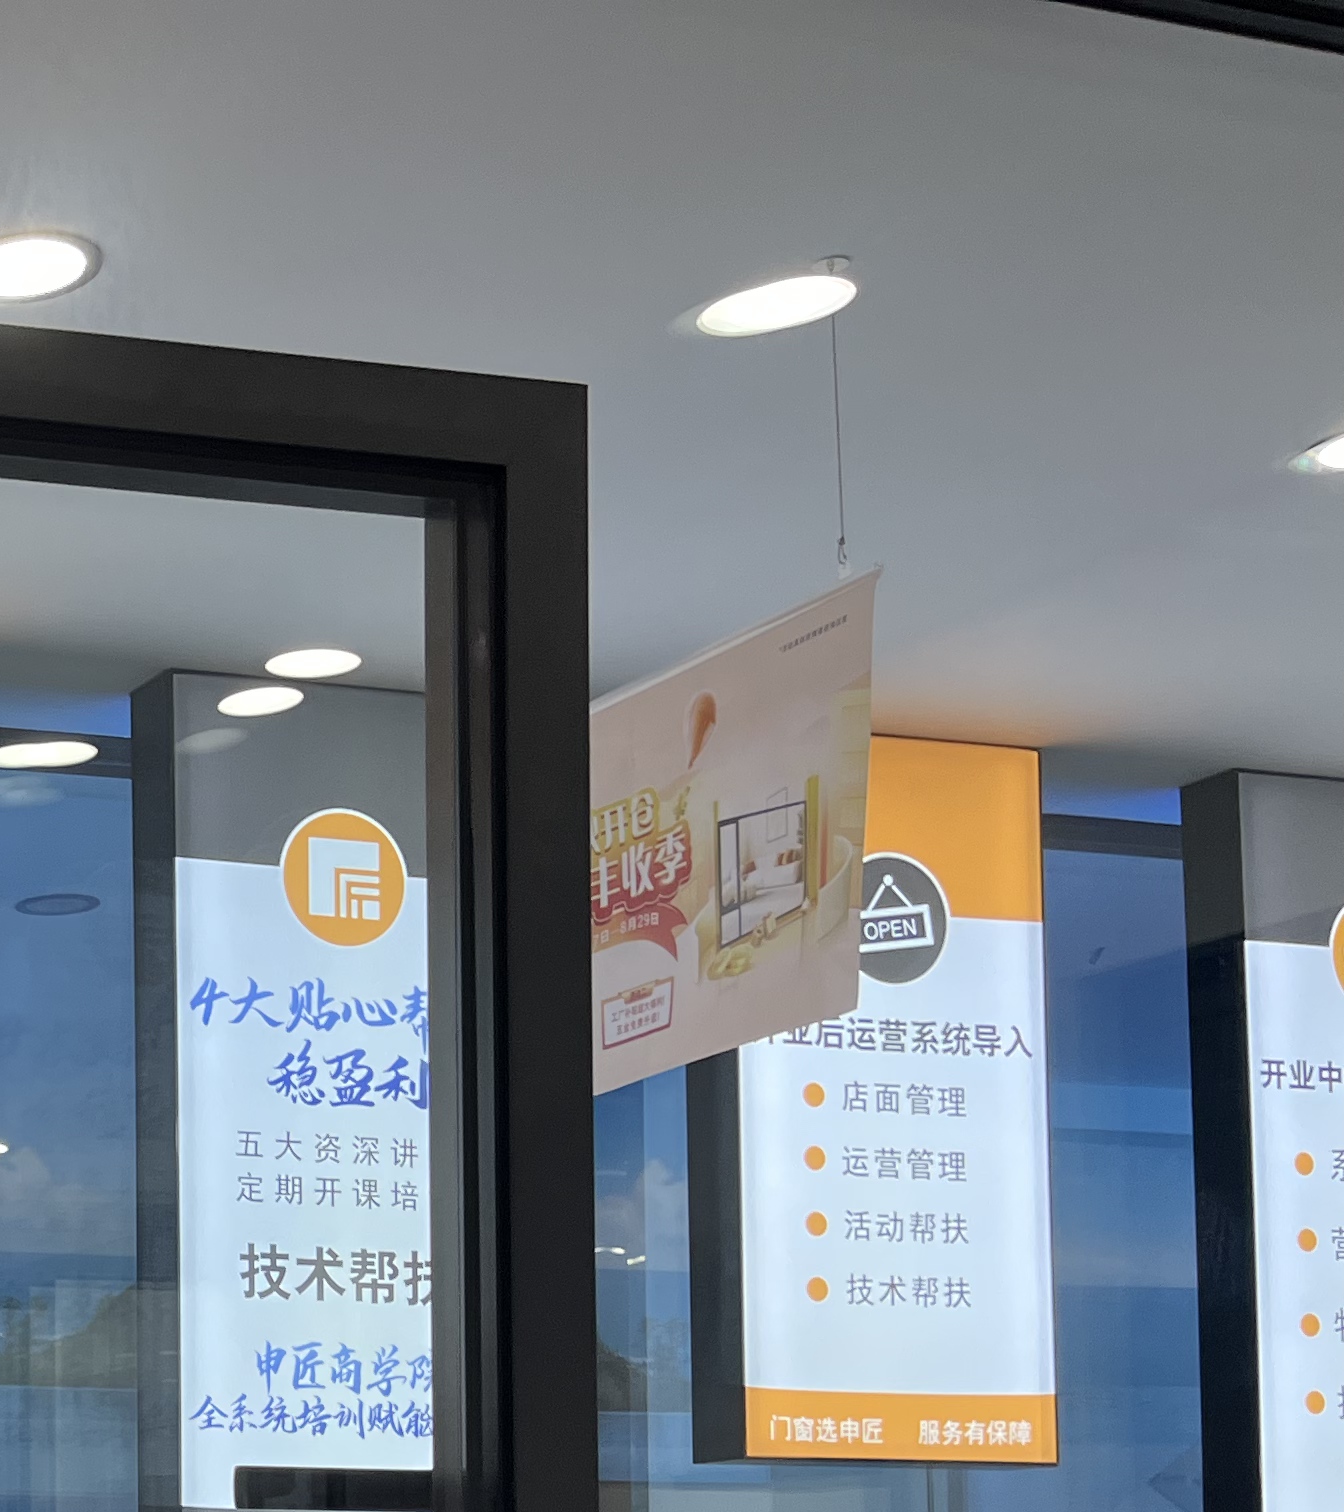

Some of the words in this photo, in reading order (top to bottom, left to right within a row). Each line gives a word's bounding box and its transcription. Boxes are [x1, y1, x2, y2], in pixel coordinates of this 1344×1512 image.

[863, 917, 918, 940] OPEN
[754, 1017, 1032, 1058] 业后运营系统导入
[267, 1038, 429, 1109] 稳盈利
[1261, 1059, 1344, 1093] 开业中
[842, 1081, 968, 1119] 店面管理
[236, 1130, 418, 1168] 五大资深讲
[842, 1146, 968, 1183] 运营管理
[236, 1172, 418, 1211] 定期开课培
[844, 1210, 969, 1246] 活动帮扶
[846, 1274, 972, 1309] 技术帮扶
[188, 1393, 433, 1439] 全系统培训赋能
[769, 1415, 883, 1444] 门窗选申匠
[918, 1419, 1031, 1445] 服务有保障
